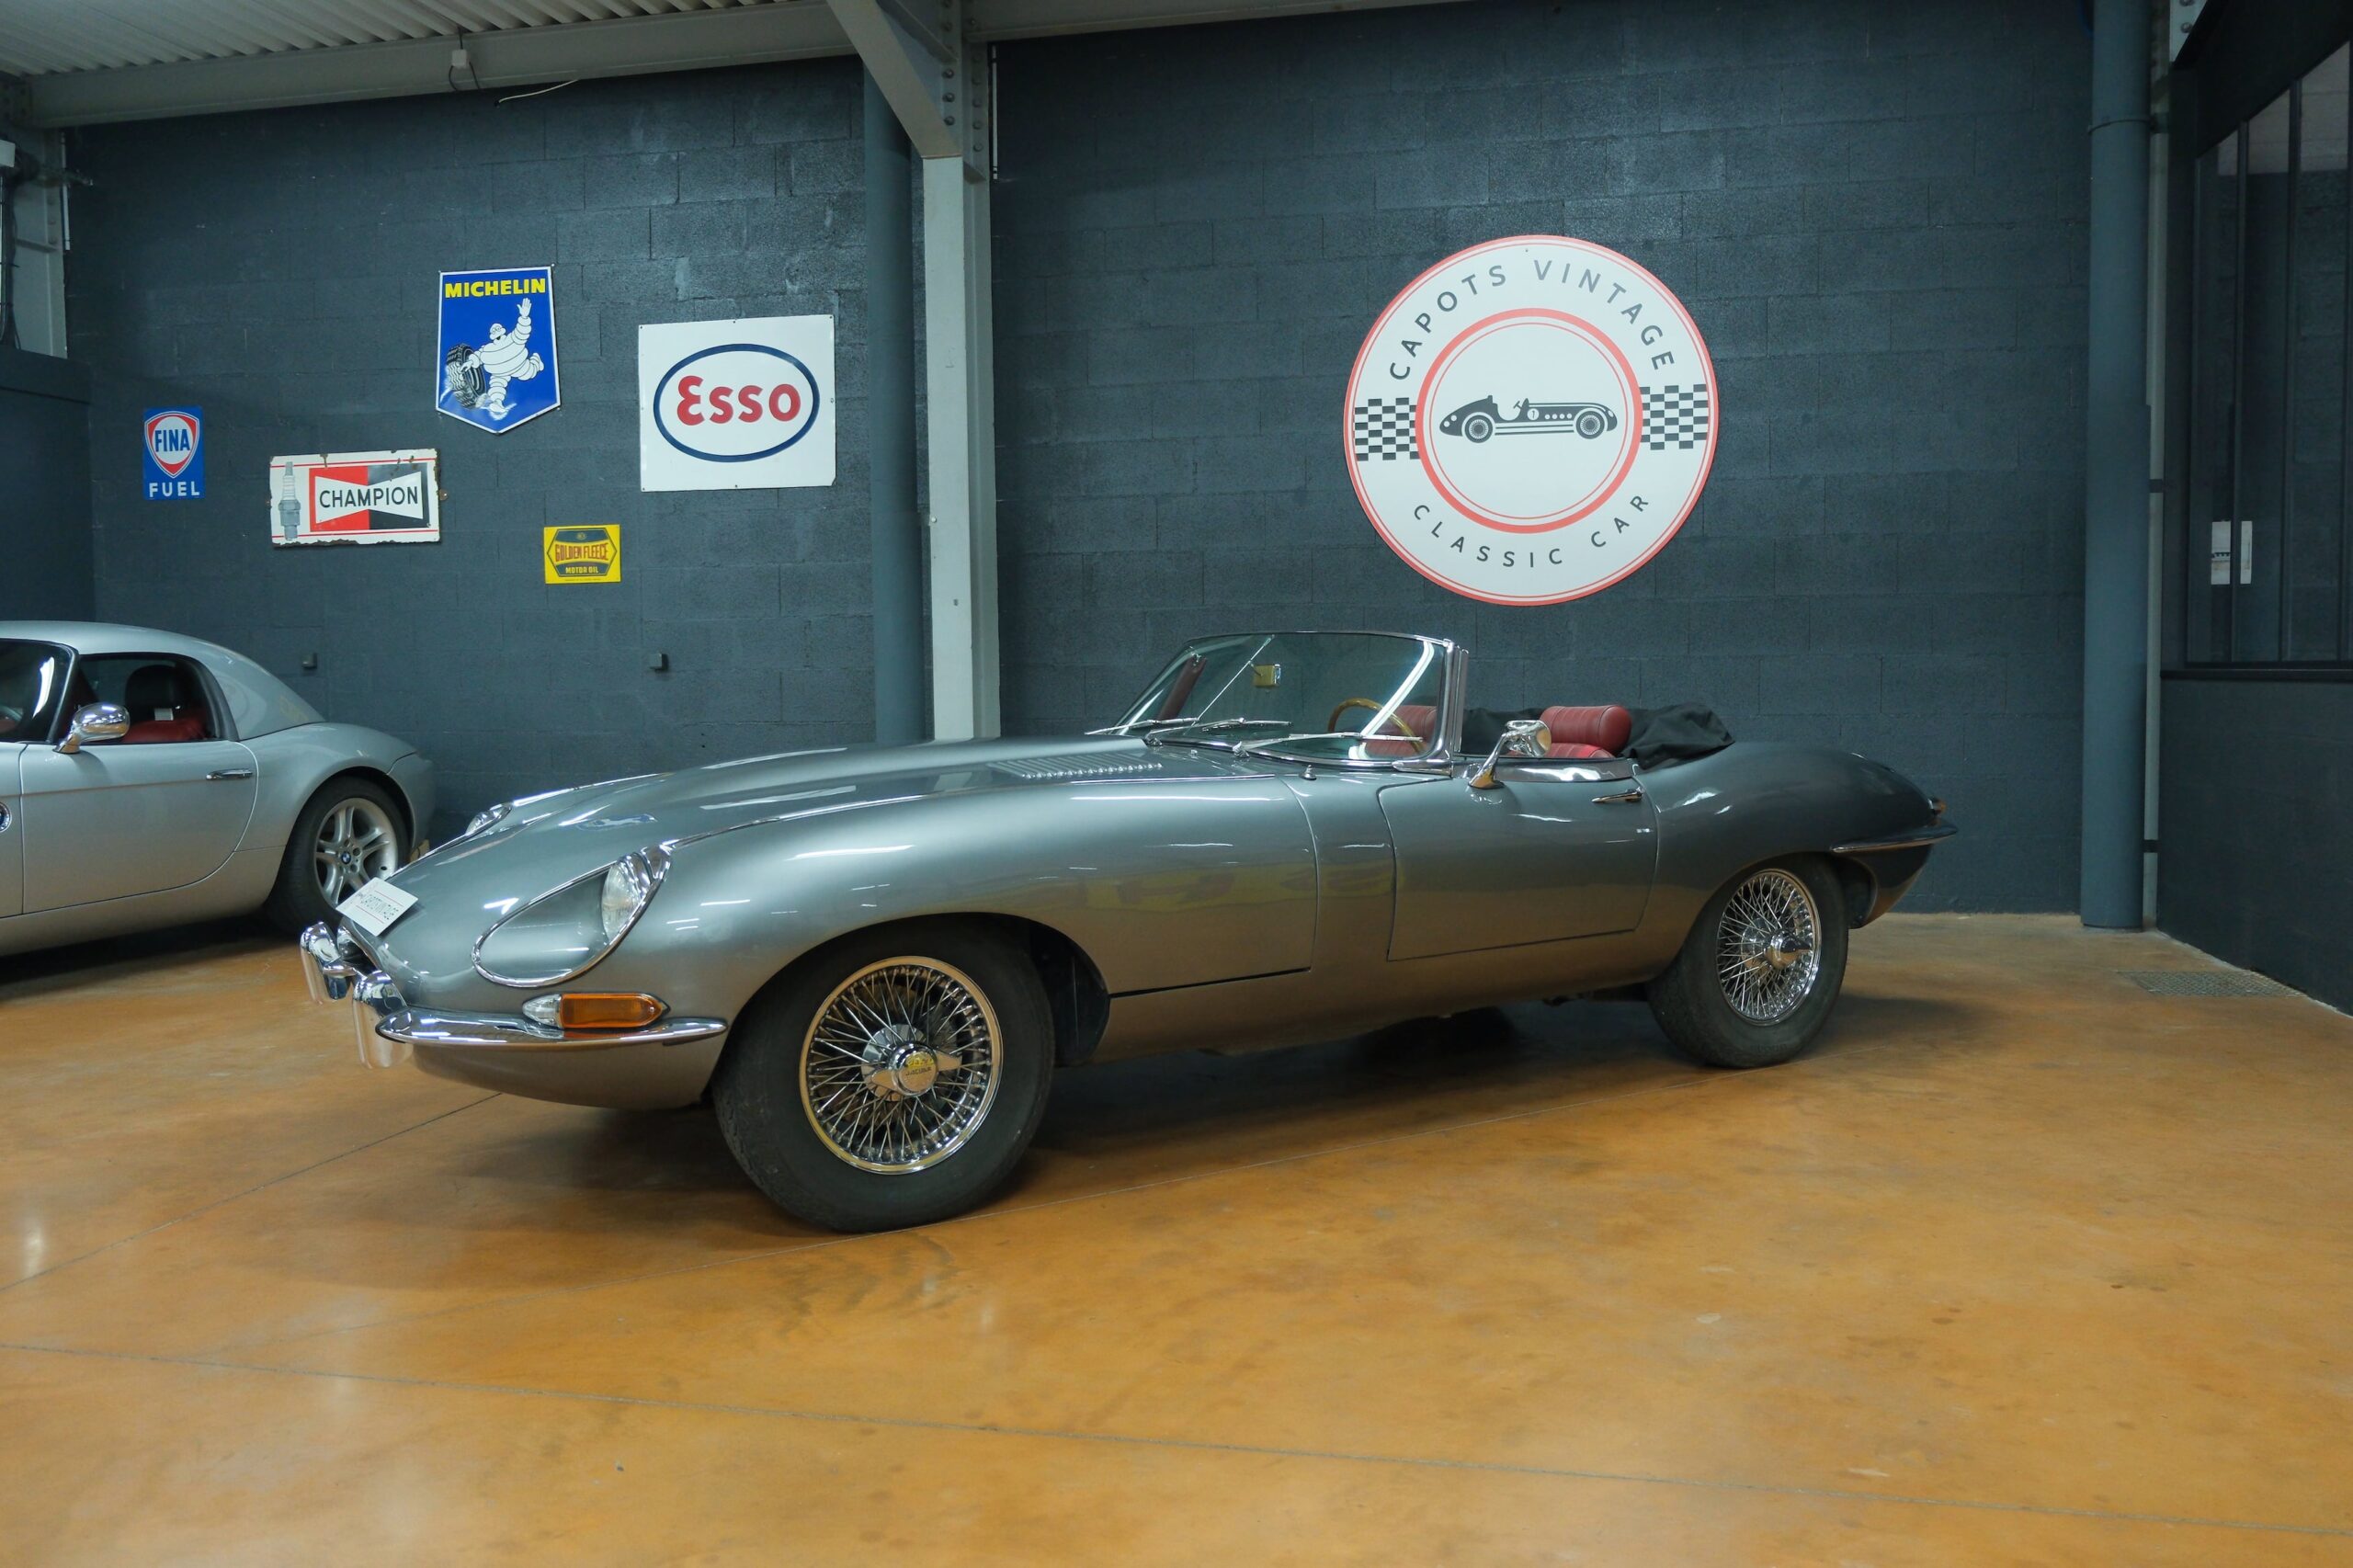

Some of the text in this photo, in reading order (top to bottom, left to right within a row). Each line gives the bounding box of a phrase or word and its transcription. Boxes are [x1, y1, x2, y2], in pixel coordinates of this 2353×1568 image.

[445, 278, 546, 299] MICHELIN
[1389, 259, 1676, 381] CAPOTS VINTAGE
[676, 375, 801, 426] Esso
[154, 428, 190, 452] FINA
[149, 481, 200, 497] FUEL
[319, 485, 418, 508] CHAMPION
[1414, 495, 1649, 569] CLASSIC CAR
[555, 542, 608, 562] GOLDEN FLEECE
[565, 565, 599, 574] MOTOR OIL
